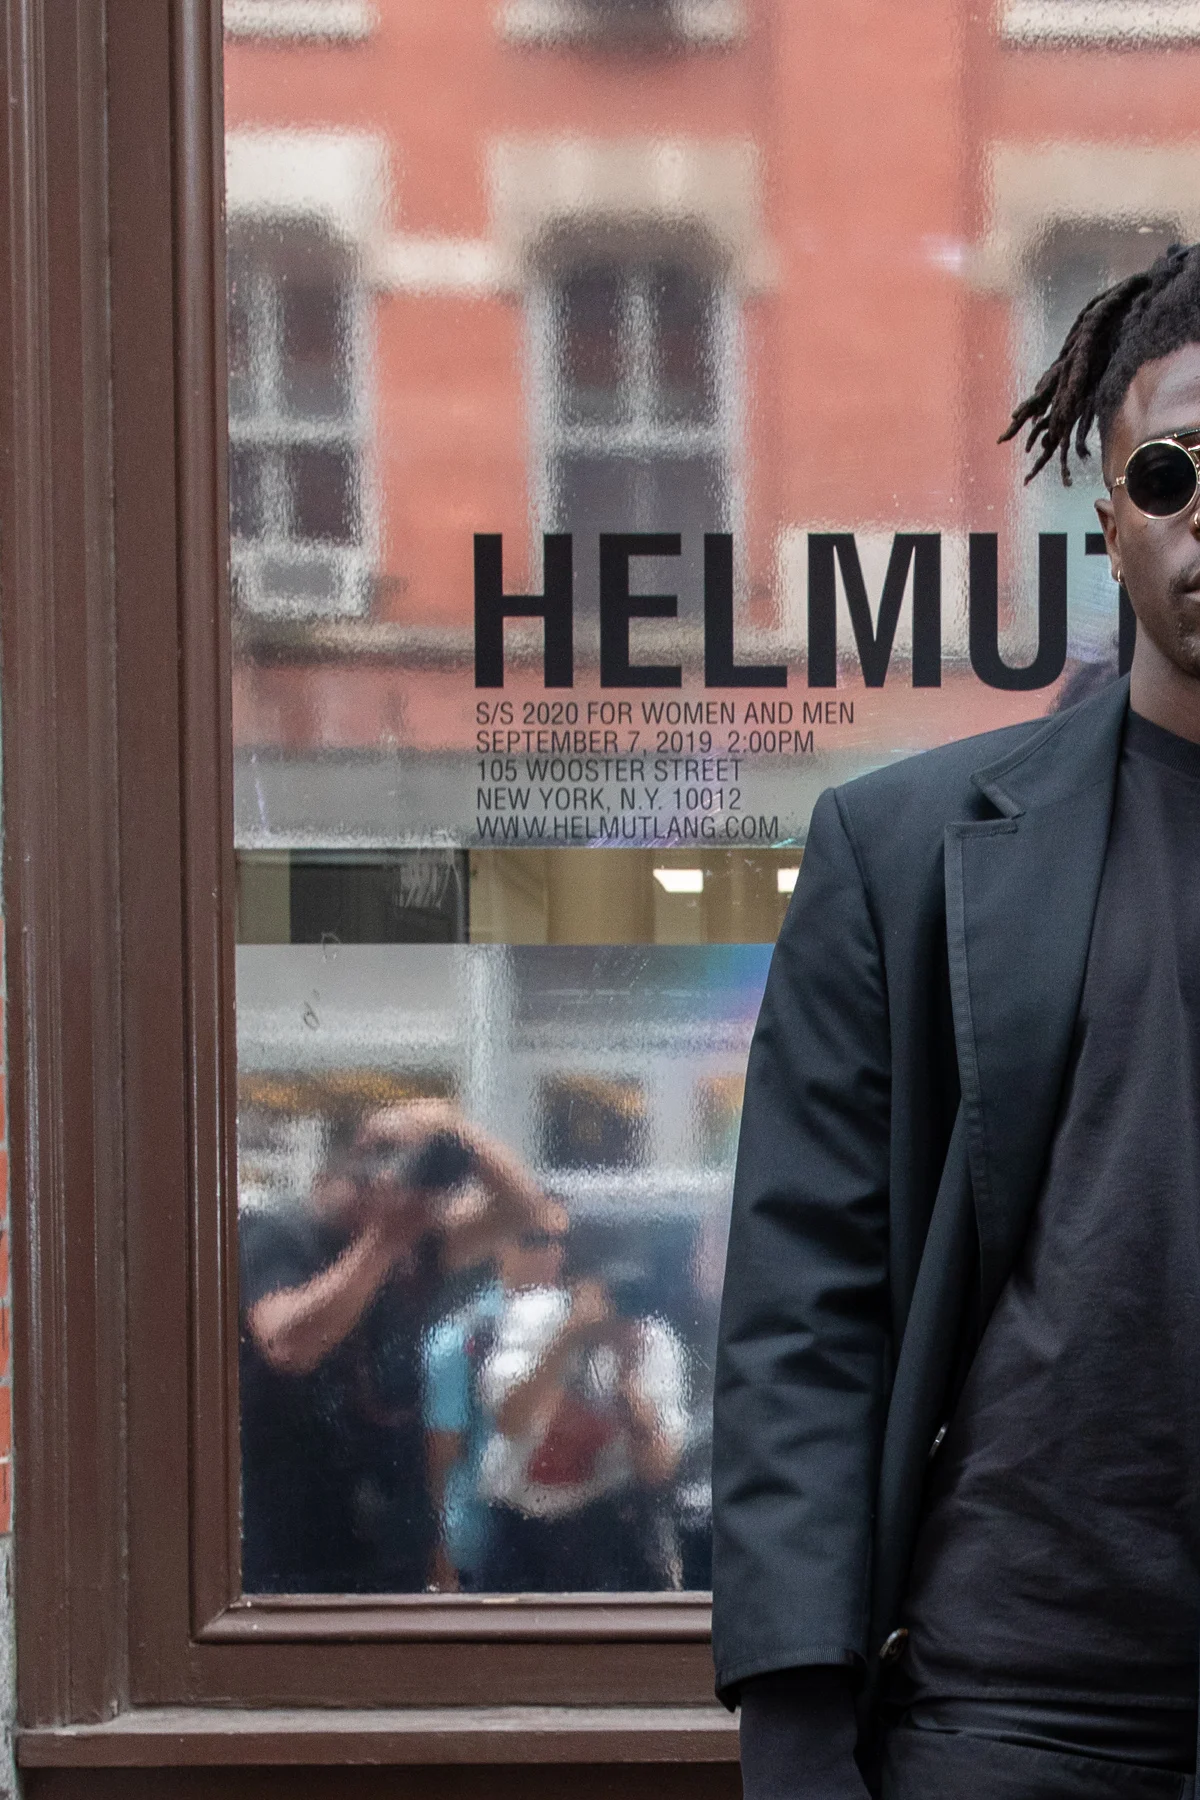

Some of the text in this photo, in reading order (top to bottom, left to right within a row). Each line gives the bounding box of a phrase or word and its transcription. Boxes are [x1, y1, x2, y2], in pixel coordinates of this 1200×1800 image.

[475, 702, 855, 725] S/S 2020 FOR WOMEN AND MEN
[475, 730, 815, 756] SEPTEMBER 7, 2019 2:00PM
[478, 758, 744, 782] 105 WOOSTER STREET
[476, 788, 742, 814] NEW YORK, N.Y. 10012
[475, 816, 780, 839] WWW.HELMUTLANG.COM
